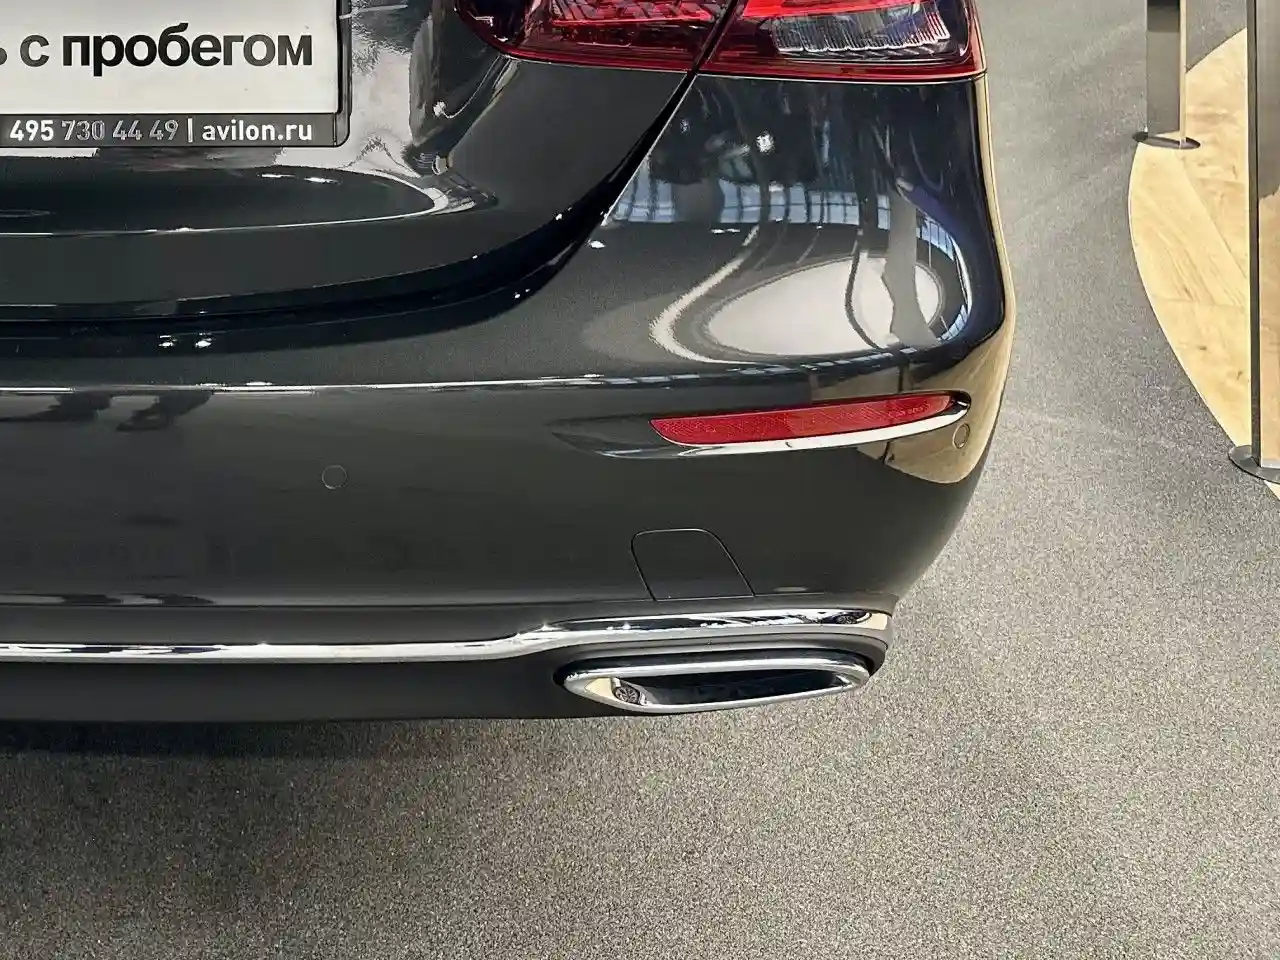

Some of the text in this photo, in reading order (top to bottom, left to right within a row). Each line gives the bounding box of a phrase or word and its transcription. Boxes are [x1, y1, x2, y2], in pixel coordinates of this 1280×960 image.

[19, 34, 50, 67] с
[62, 22, 313, 77] пробегом
[10, 119, 313, 141] 495 730 44 49 avilon.ru
